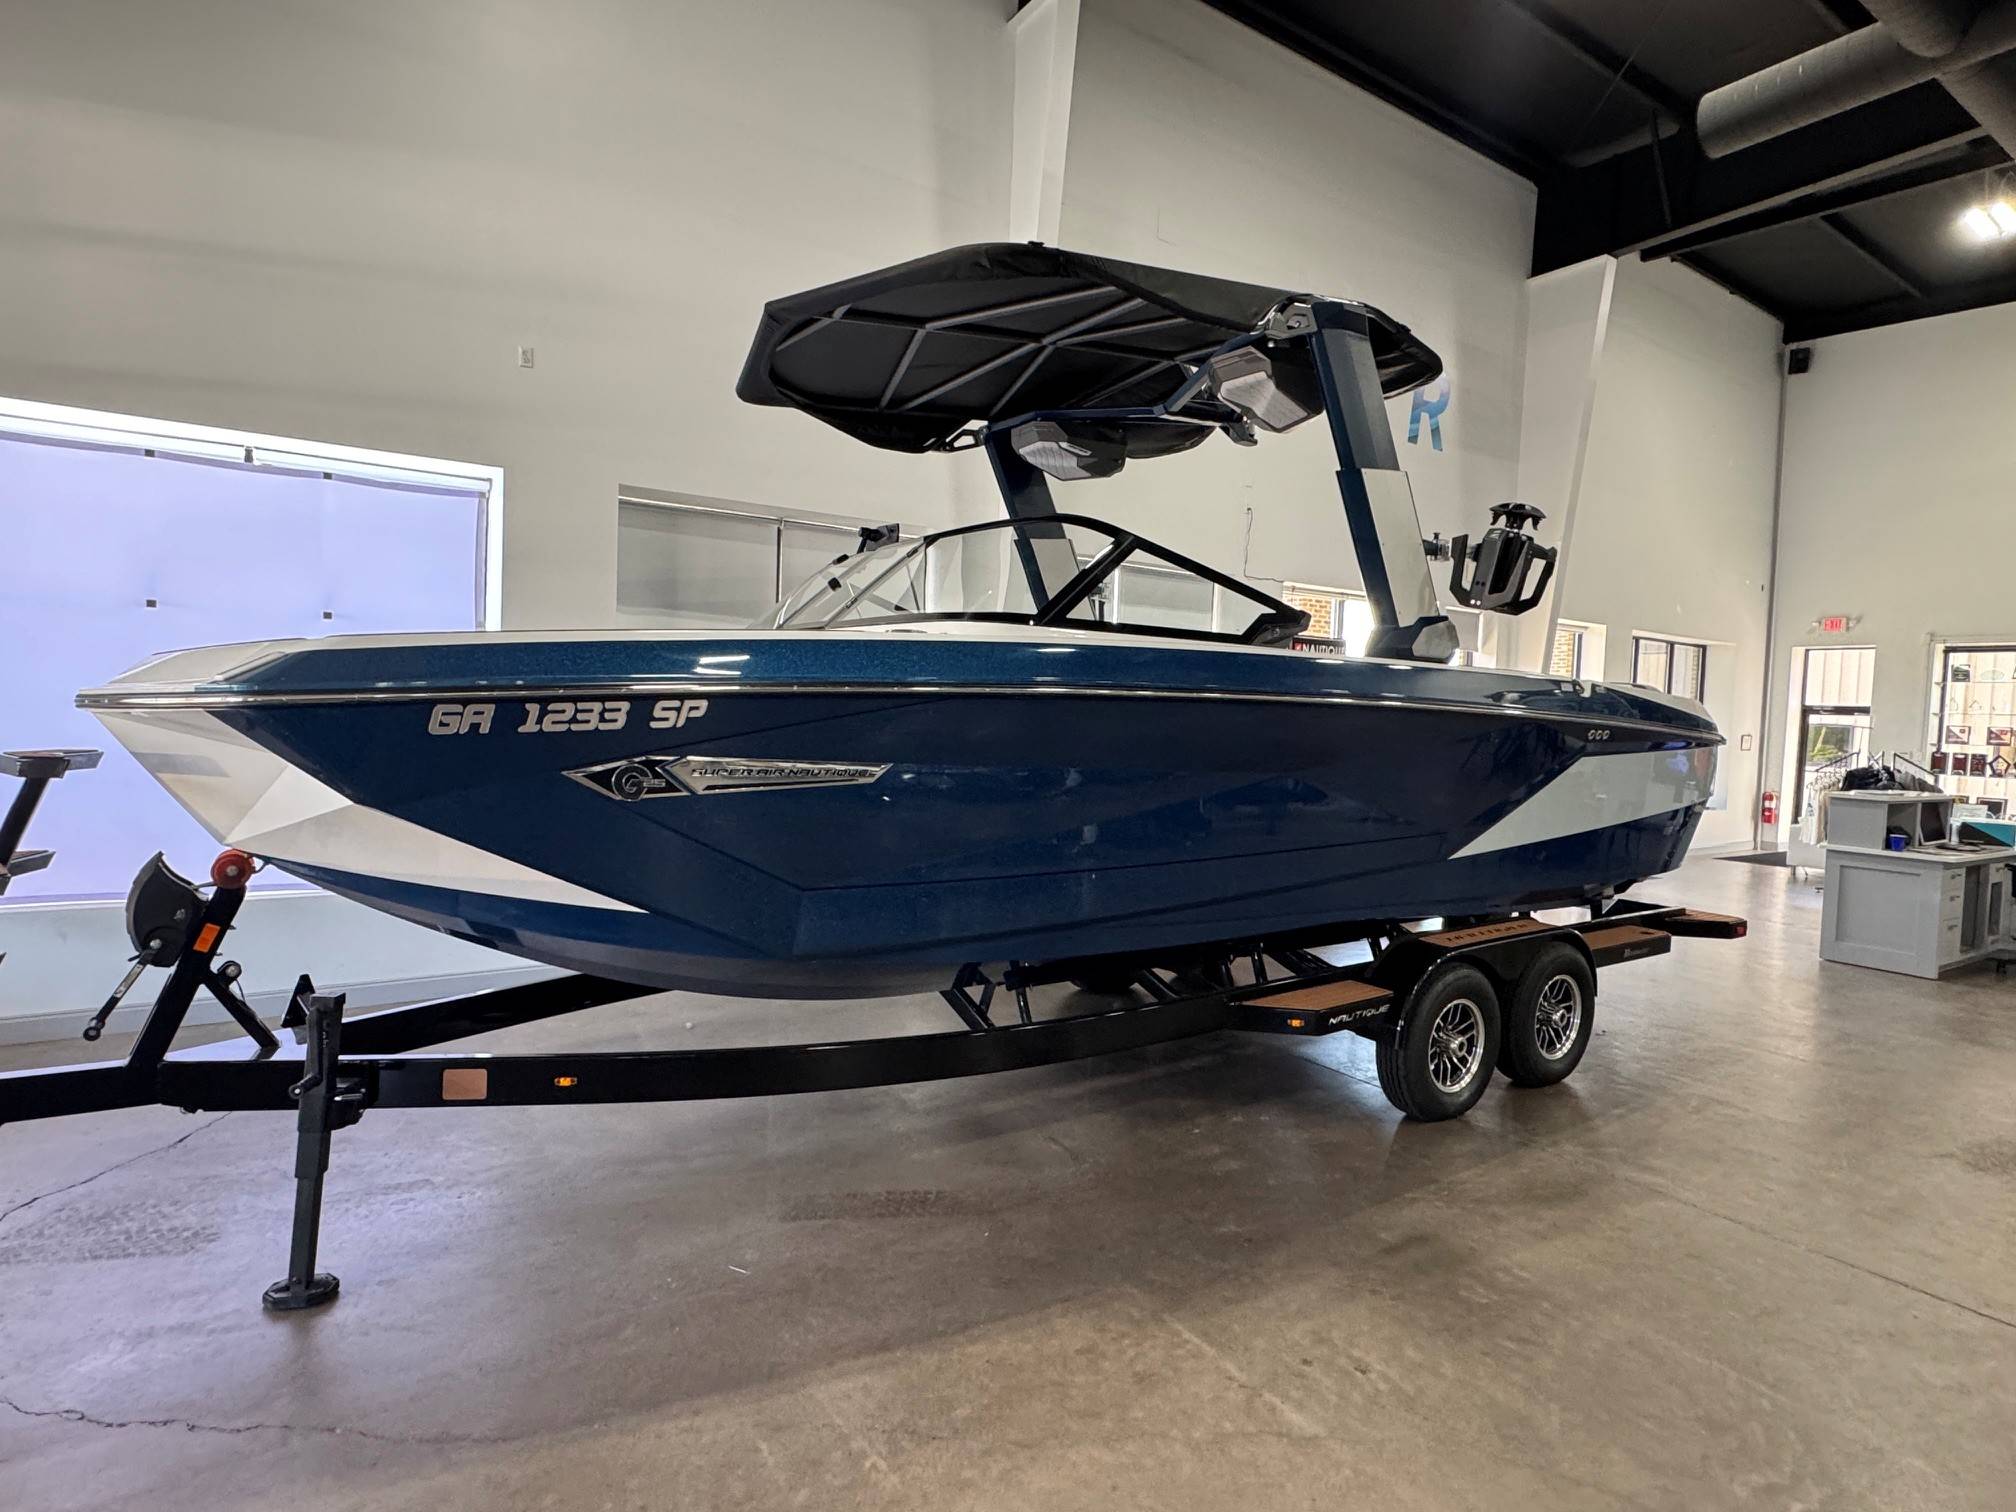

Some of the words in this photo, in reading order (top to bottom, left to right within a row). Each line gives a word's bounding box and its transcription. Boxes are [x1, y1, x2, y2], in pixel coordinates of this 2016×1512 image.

[428, 703, 496, 735] GA
[517, 701, 631, 733] 1233
[649, 699, 709, 728] SP
[691, 768, 754, 777] SUPER
[755, 767, 785, 777] AIR
[787, 768, 870, 777] NAUTIQUE
[1328, 1003, 1391, 1026] NAUTIQUE
